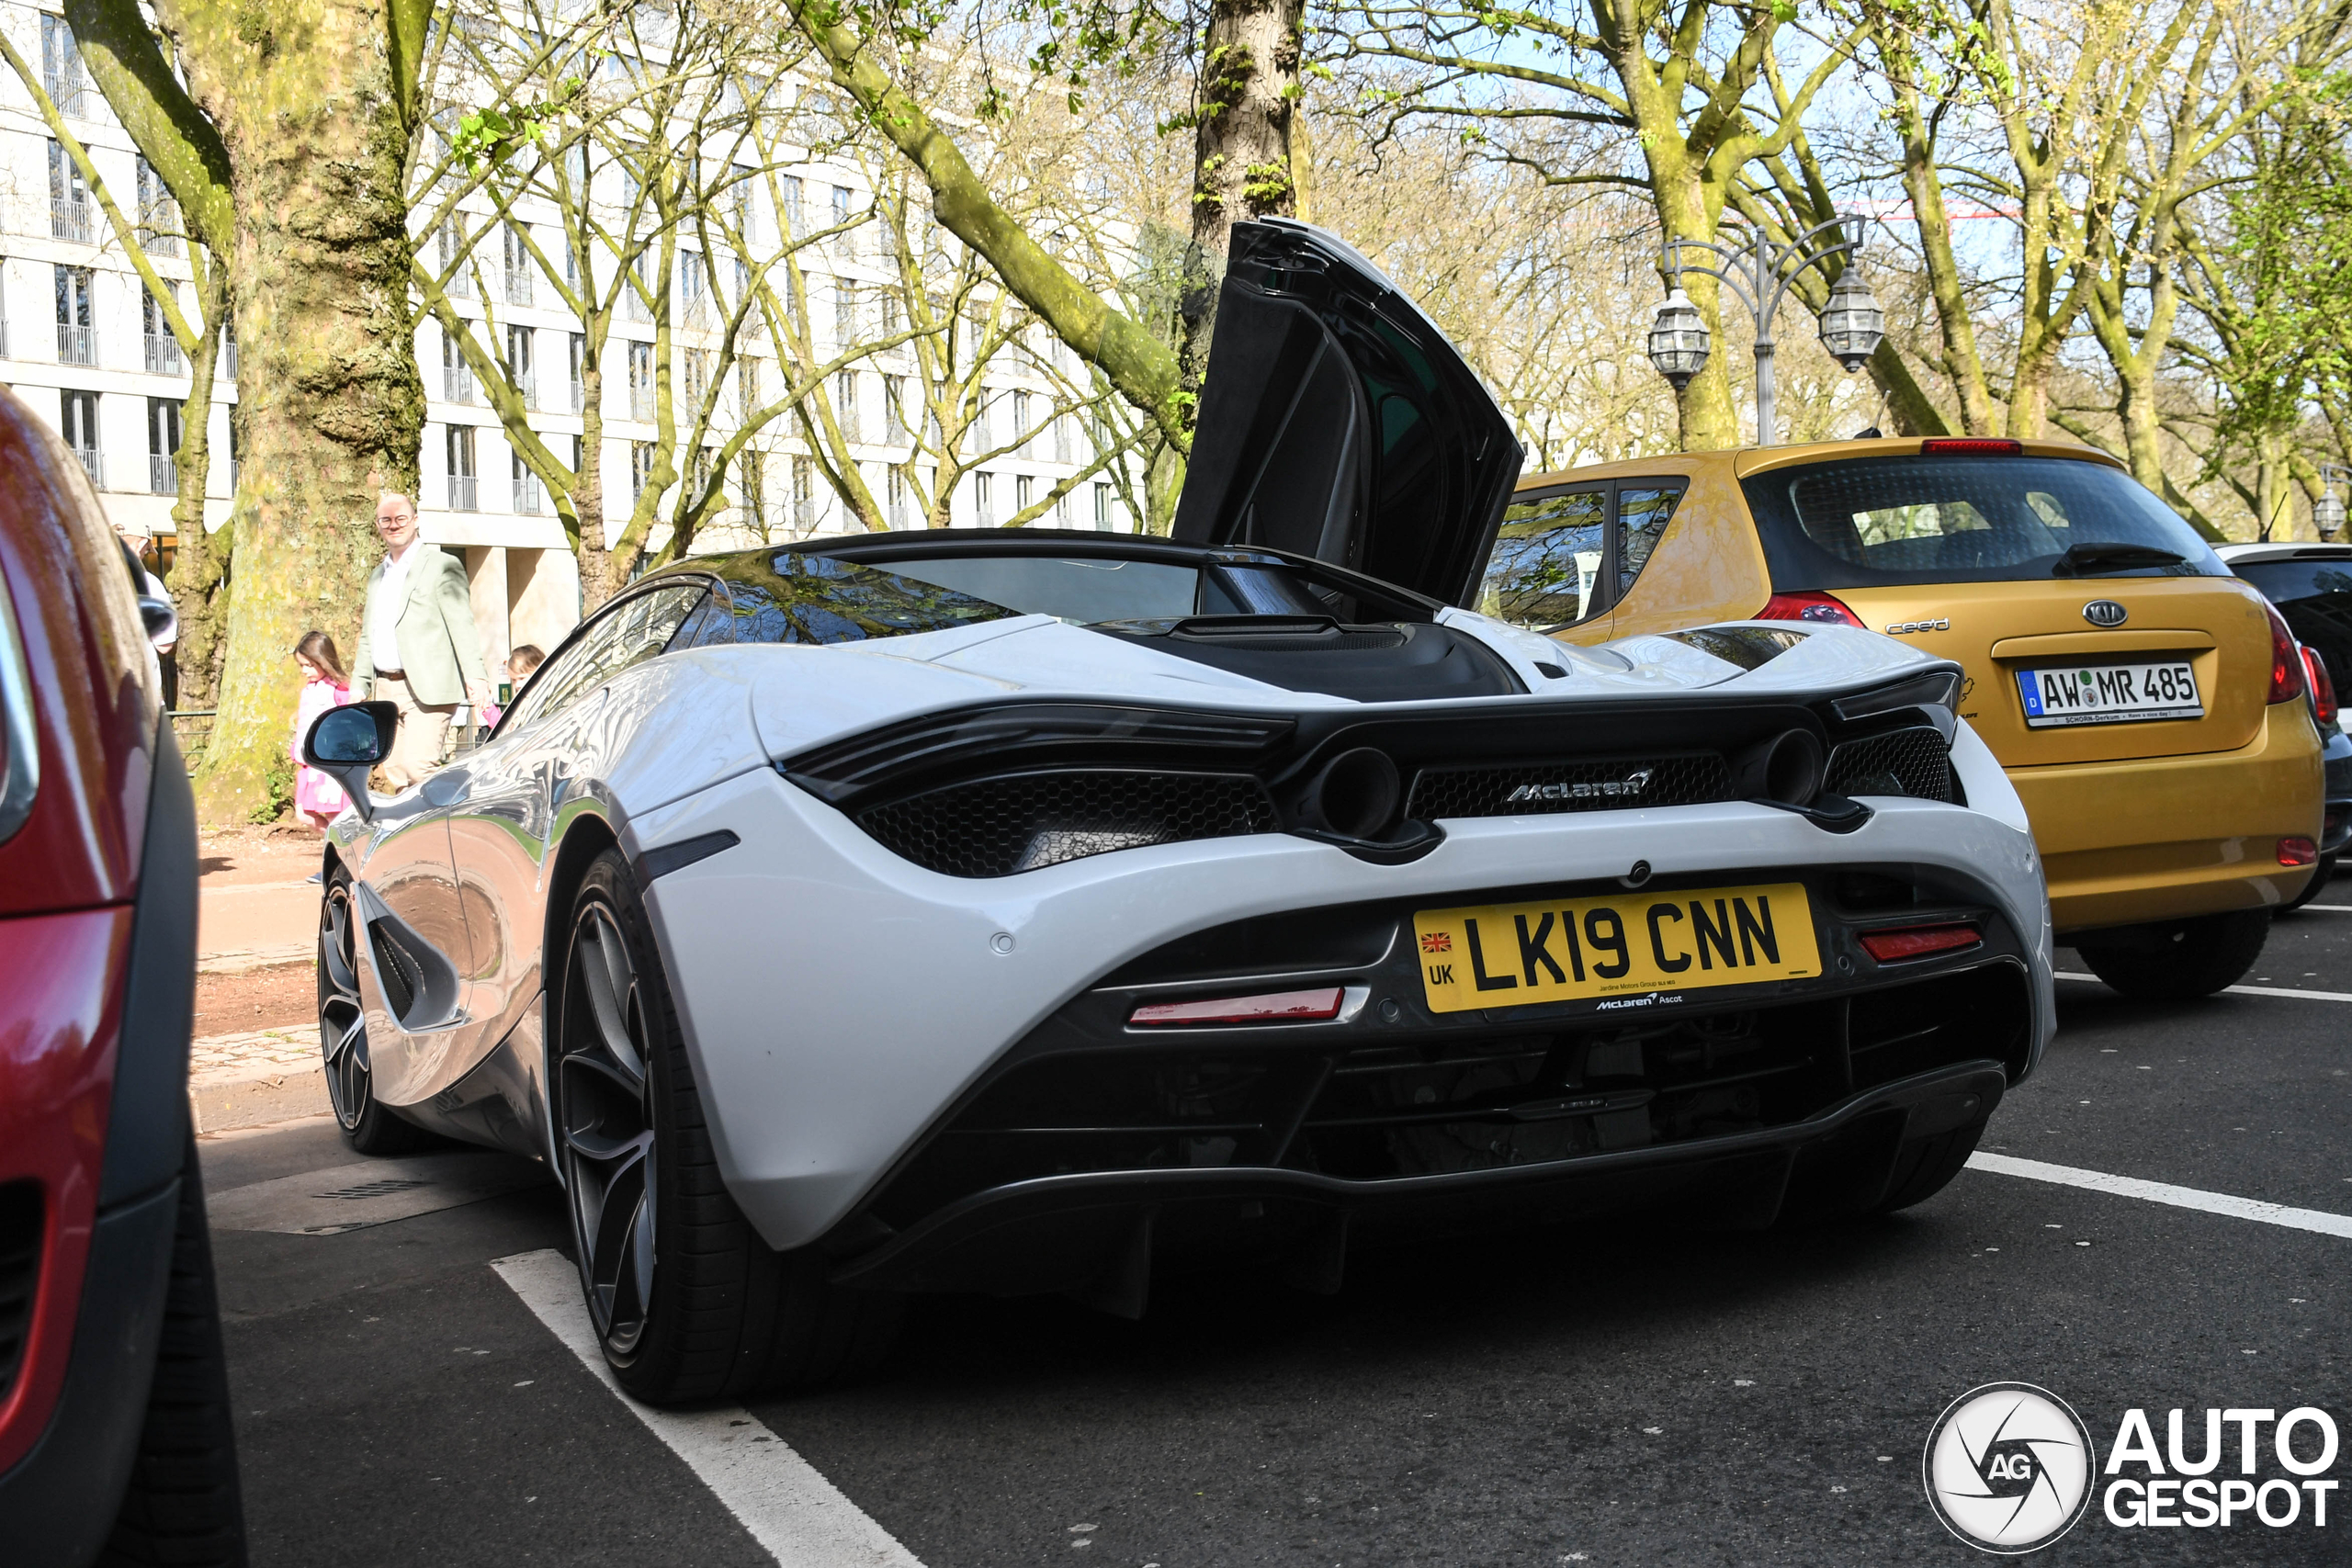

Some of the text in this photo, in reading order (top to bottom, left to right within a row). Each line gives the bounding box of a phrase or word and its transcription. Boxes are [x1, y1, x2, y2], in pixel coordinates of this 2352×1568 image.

[2090, 605, 2122, 623] KIA
[2042, 667, 2194, 708] AW MR 485
[2029, 697, 2037, 708] D
[1507, 781, 1639, 802] McLaren
[1464, 895, 1781, 992] LK19 CNN
[1429, 964, 1454, 986] UK
[1600, 983, 1619, 991] Jardine
[1640, 980, 1657, 988] Group
[1596, 995, 1682, 1010] McLaren Ascot
